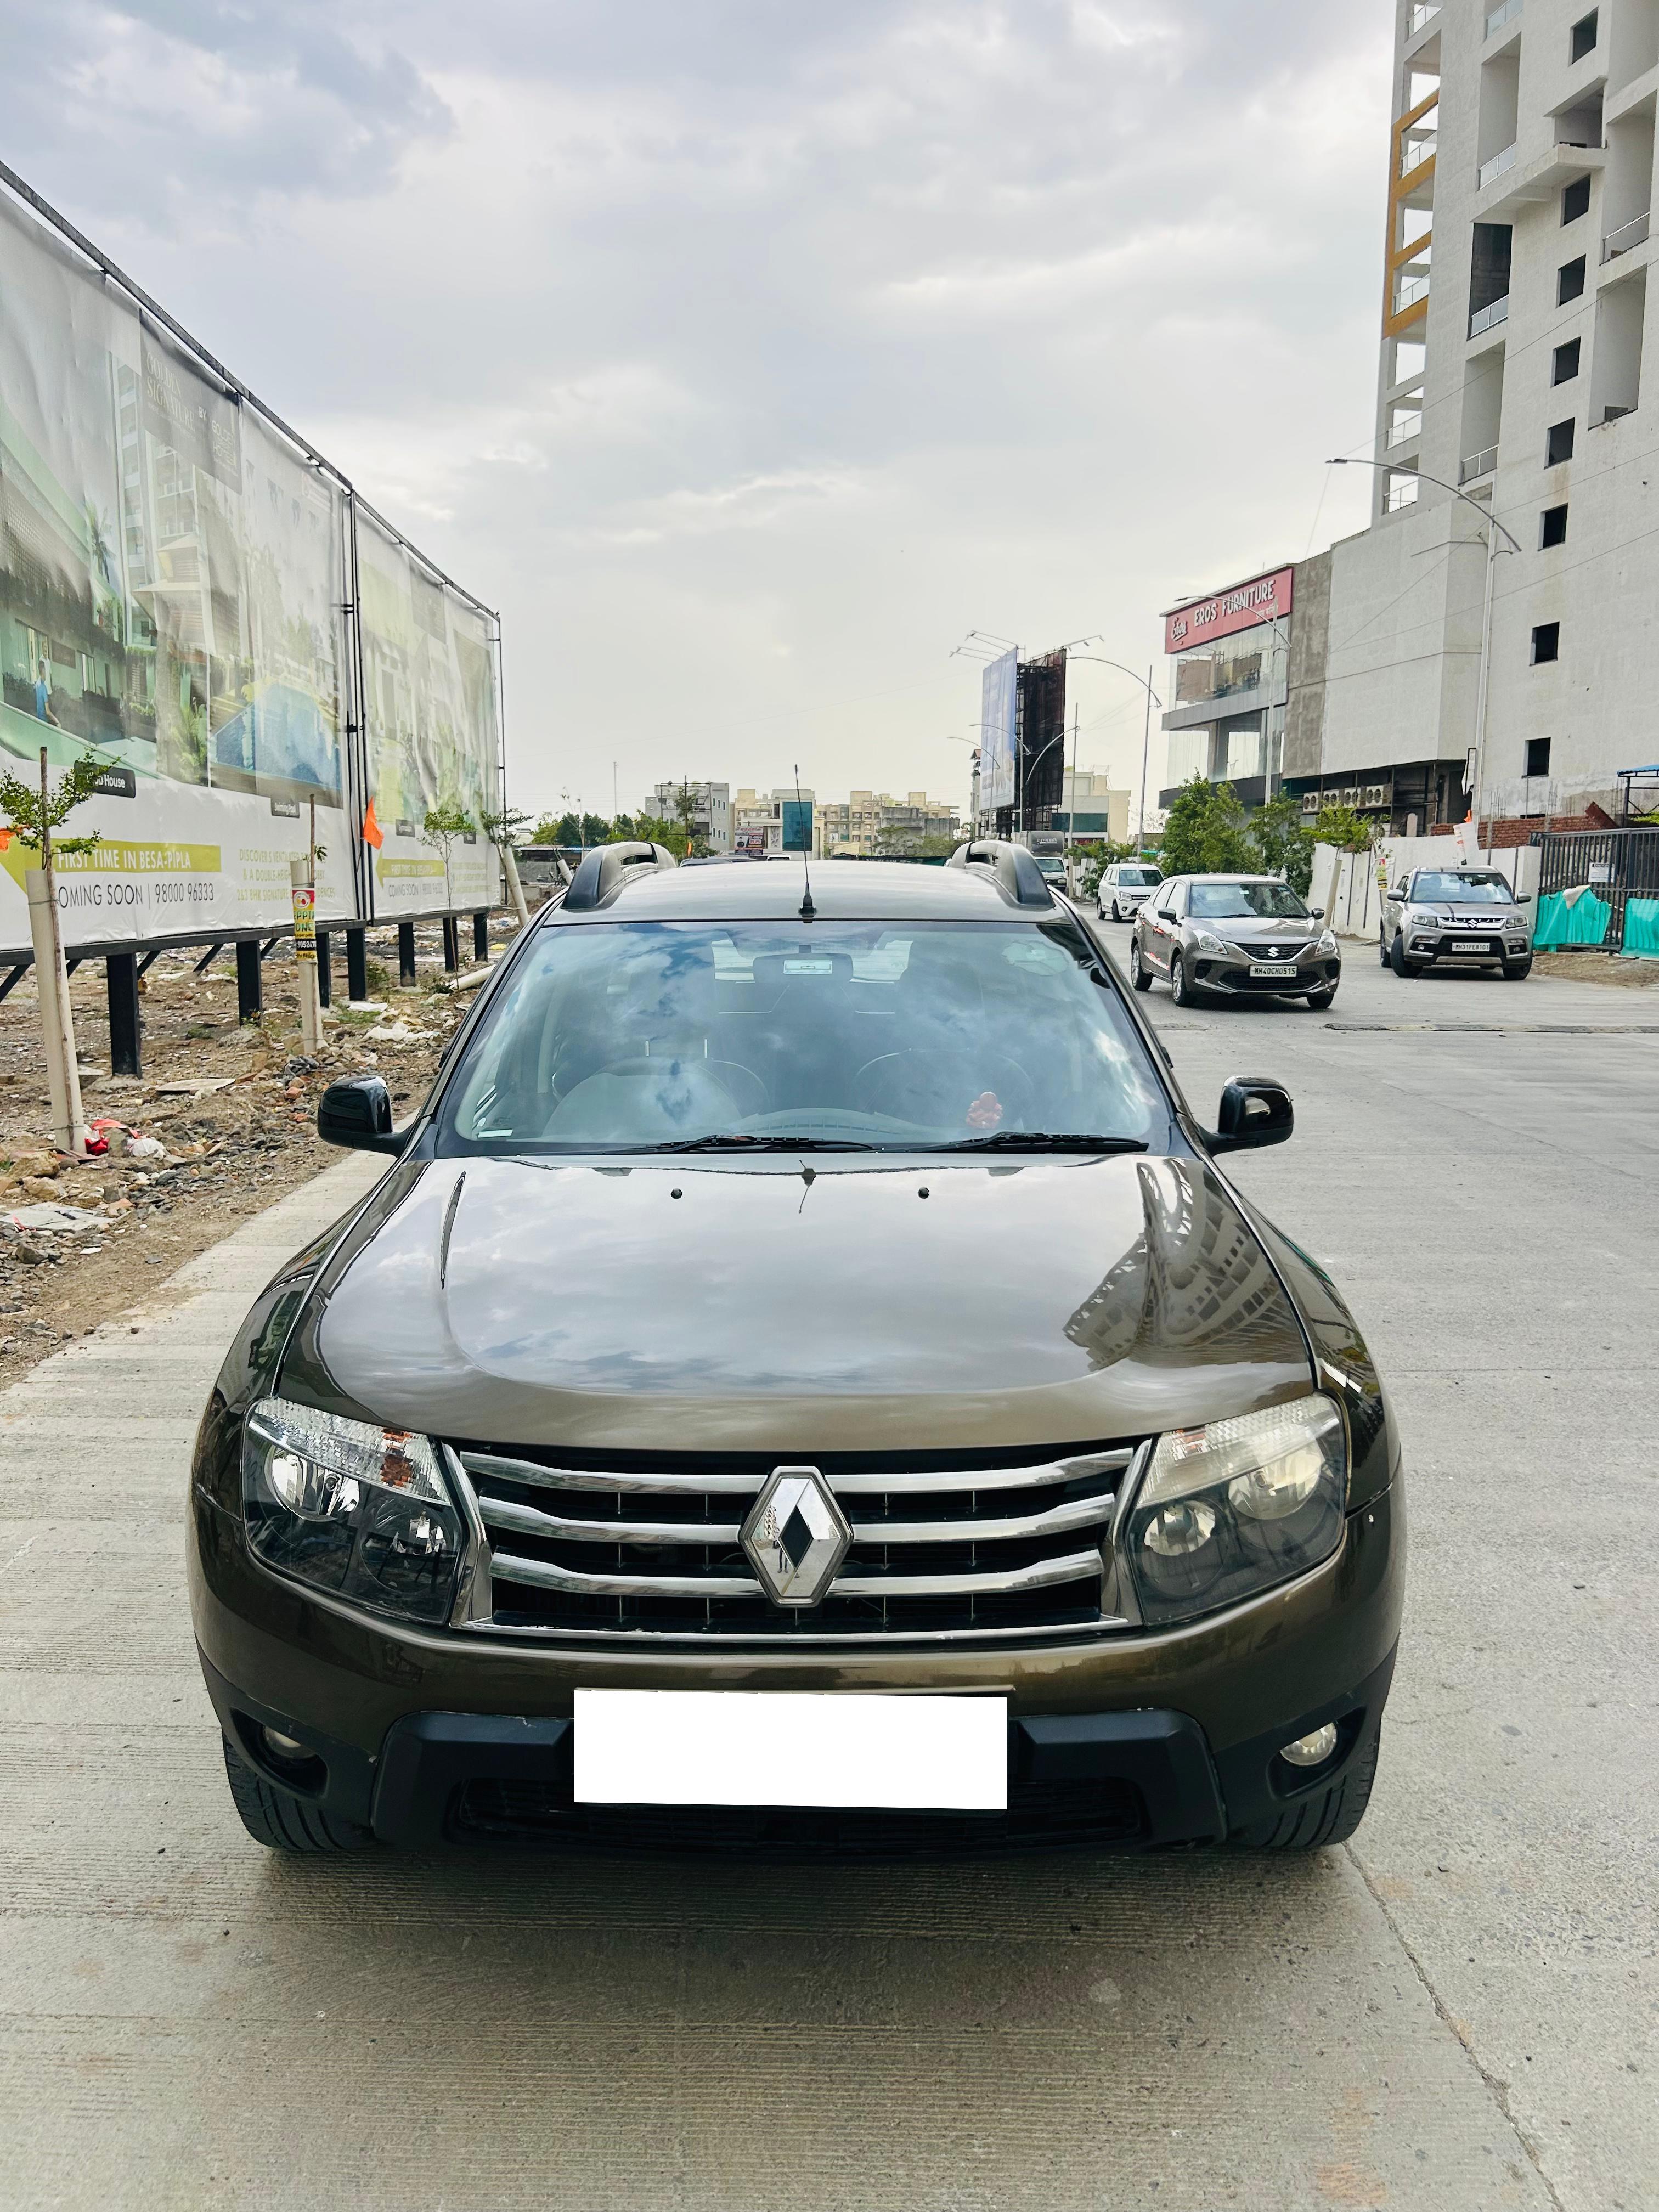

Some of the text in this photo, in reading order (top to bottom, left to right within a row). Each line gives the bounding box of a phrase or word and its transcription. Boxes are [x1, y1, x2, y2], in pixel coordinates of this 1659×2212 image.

[199, 405, 206, 421] BY
[1194, 603, 1217, 627] EROS
[1222, 580, 1275, 617] FURNITURE
[104, 774, 125, 788] House
[58, 849, 191, 870] FIRST TIME IN BESA-PIPLA
[58, 883, 214, 909] OMING SOON 98000 96333
